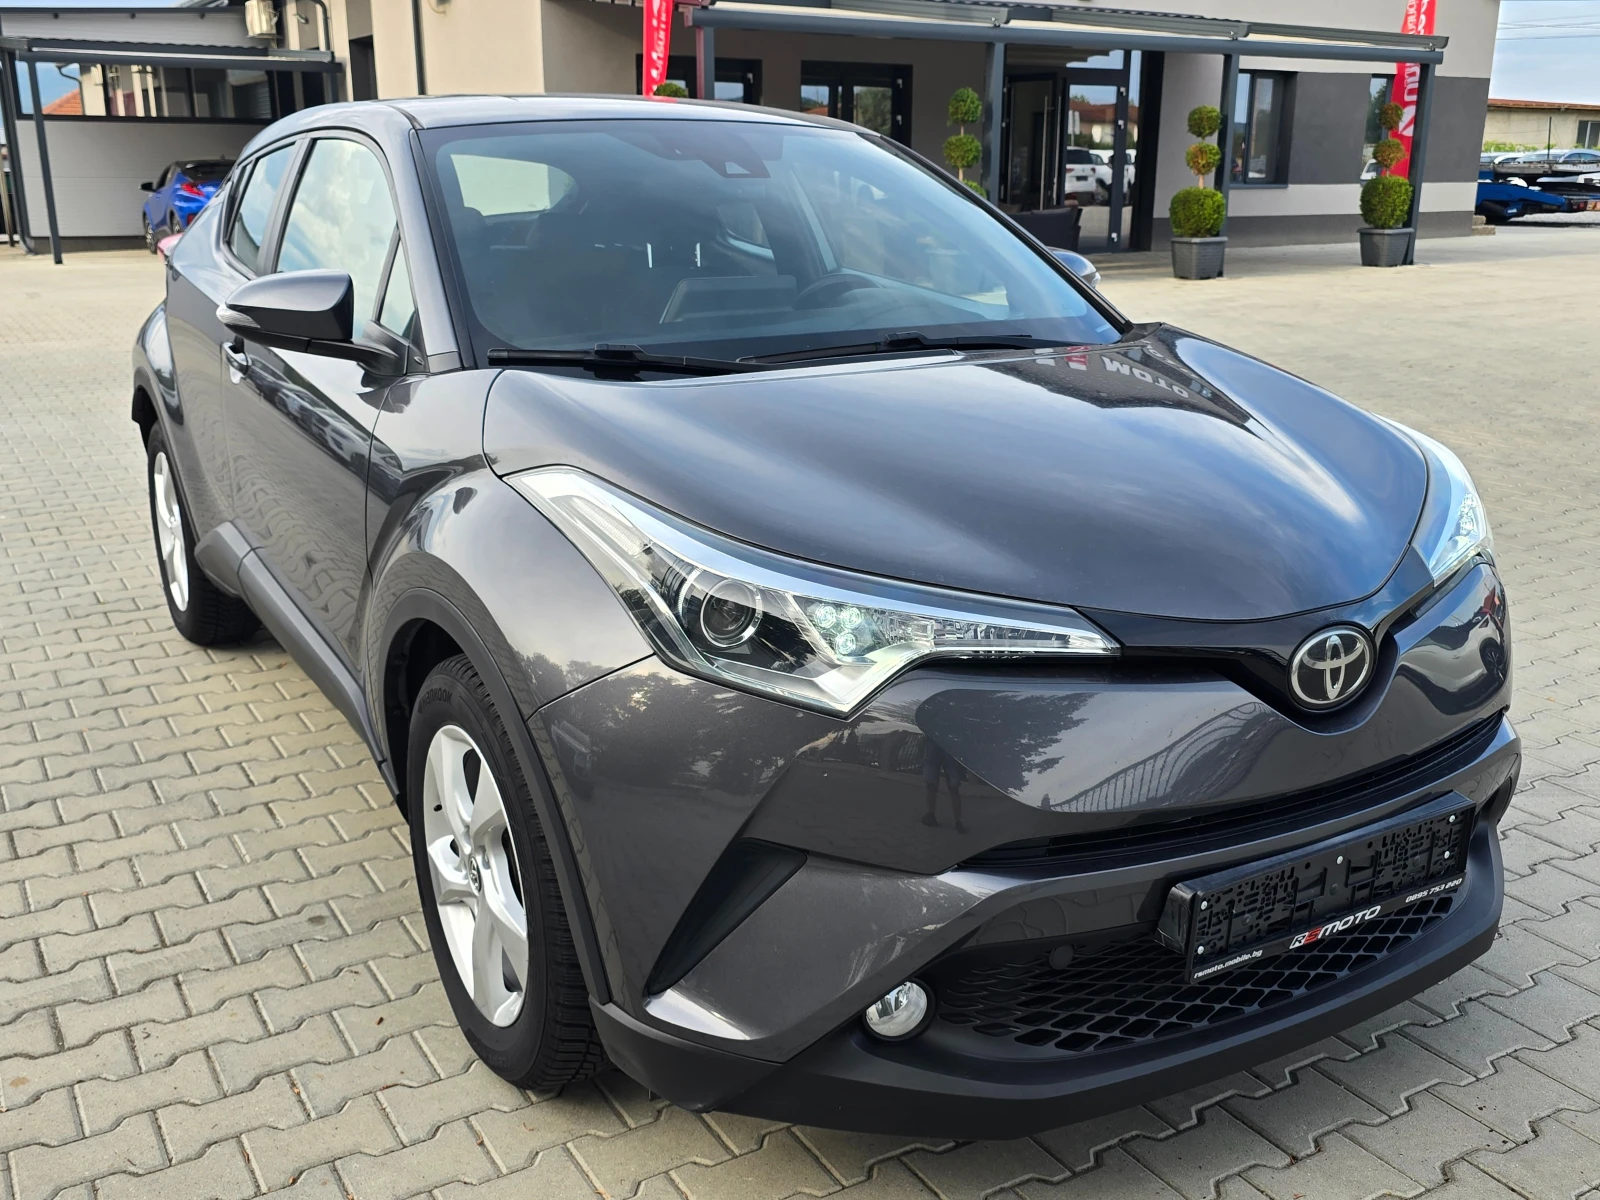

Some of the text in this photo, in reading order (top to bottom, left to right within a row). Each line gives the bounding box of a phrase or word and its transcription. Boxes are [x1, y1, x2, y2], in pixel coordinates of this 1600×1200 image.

[1405, 877, 1463, 903] 0895 753 220
[1193, 949, 1263, 979] rsmoto.mobile.bg
